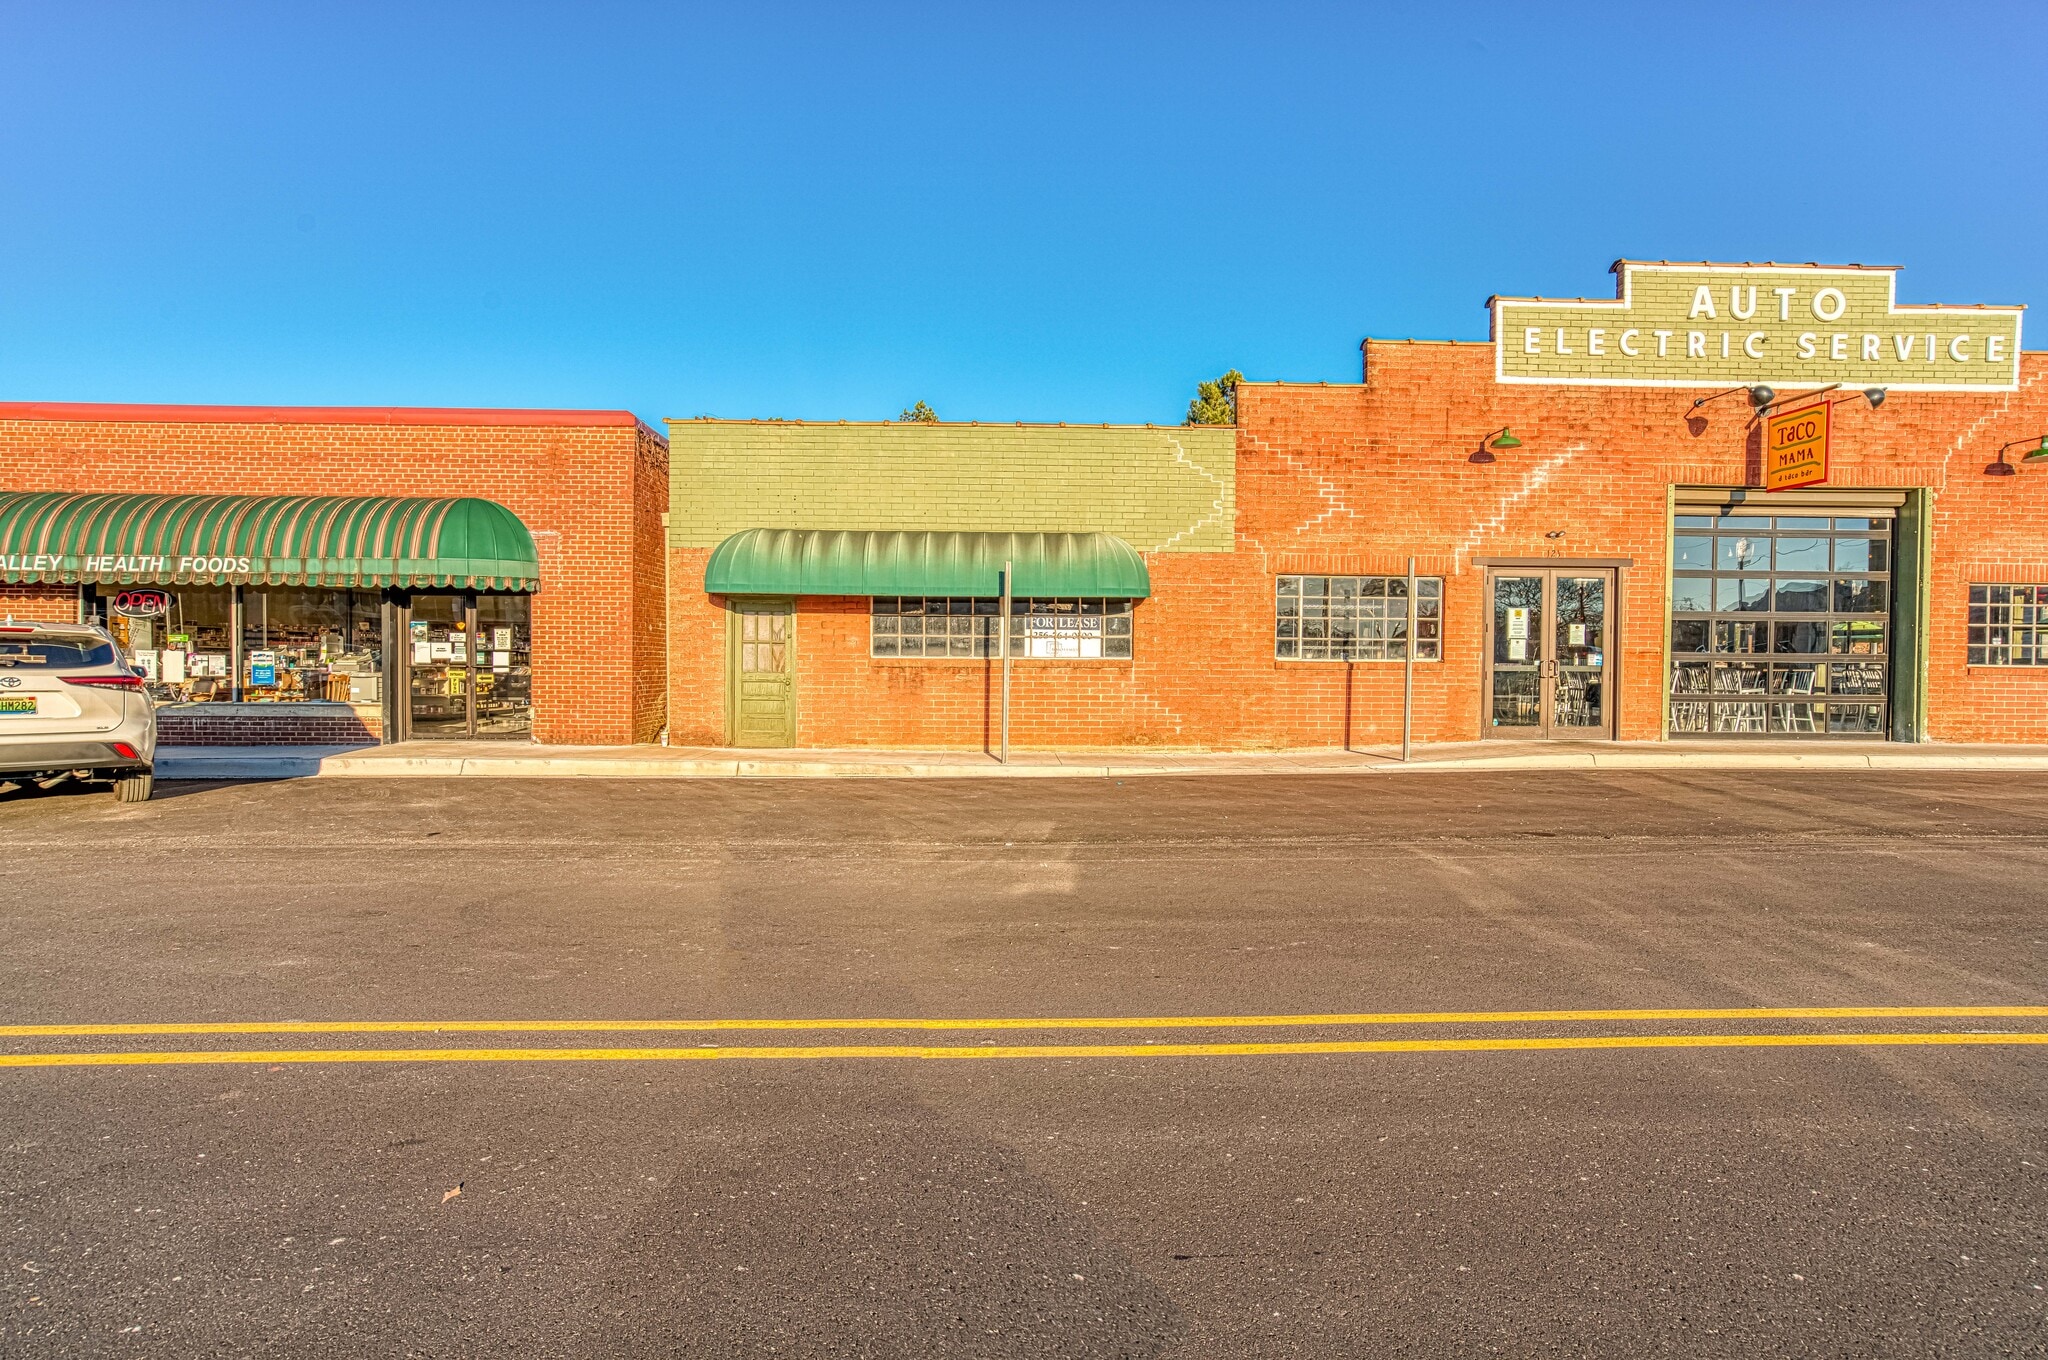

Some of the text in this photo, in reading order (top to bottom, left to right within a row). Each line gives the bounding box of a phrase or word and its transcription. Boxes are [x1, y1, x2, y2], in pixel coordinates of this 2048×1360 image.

[1686, 285, 1847, 322] AUTO
[1523, 327, 2005, 363] ELECTRIC SERVICE
[1779, 447, 1814, 466] MAMA
[1784, 472, 1798, 481] taco
[1800, 469, 1813, 477] bar
[86, 556, 164, 573] HEALTH
[179, 557, 250, 573] FOODS
[115, 592, 167, 614] OPEN
[1031, 617, 1098, 628] FOR LEASE
